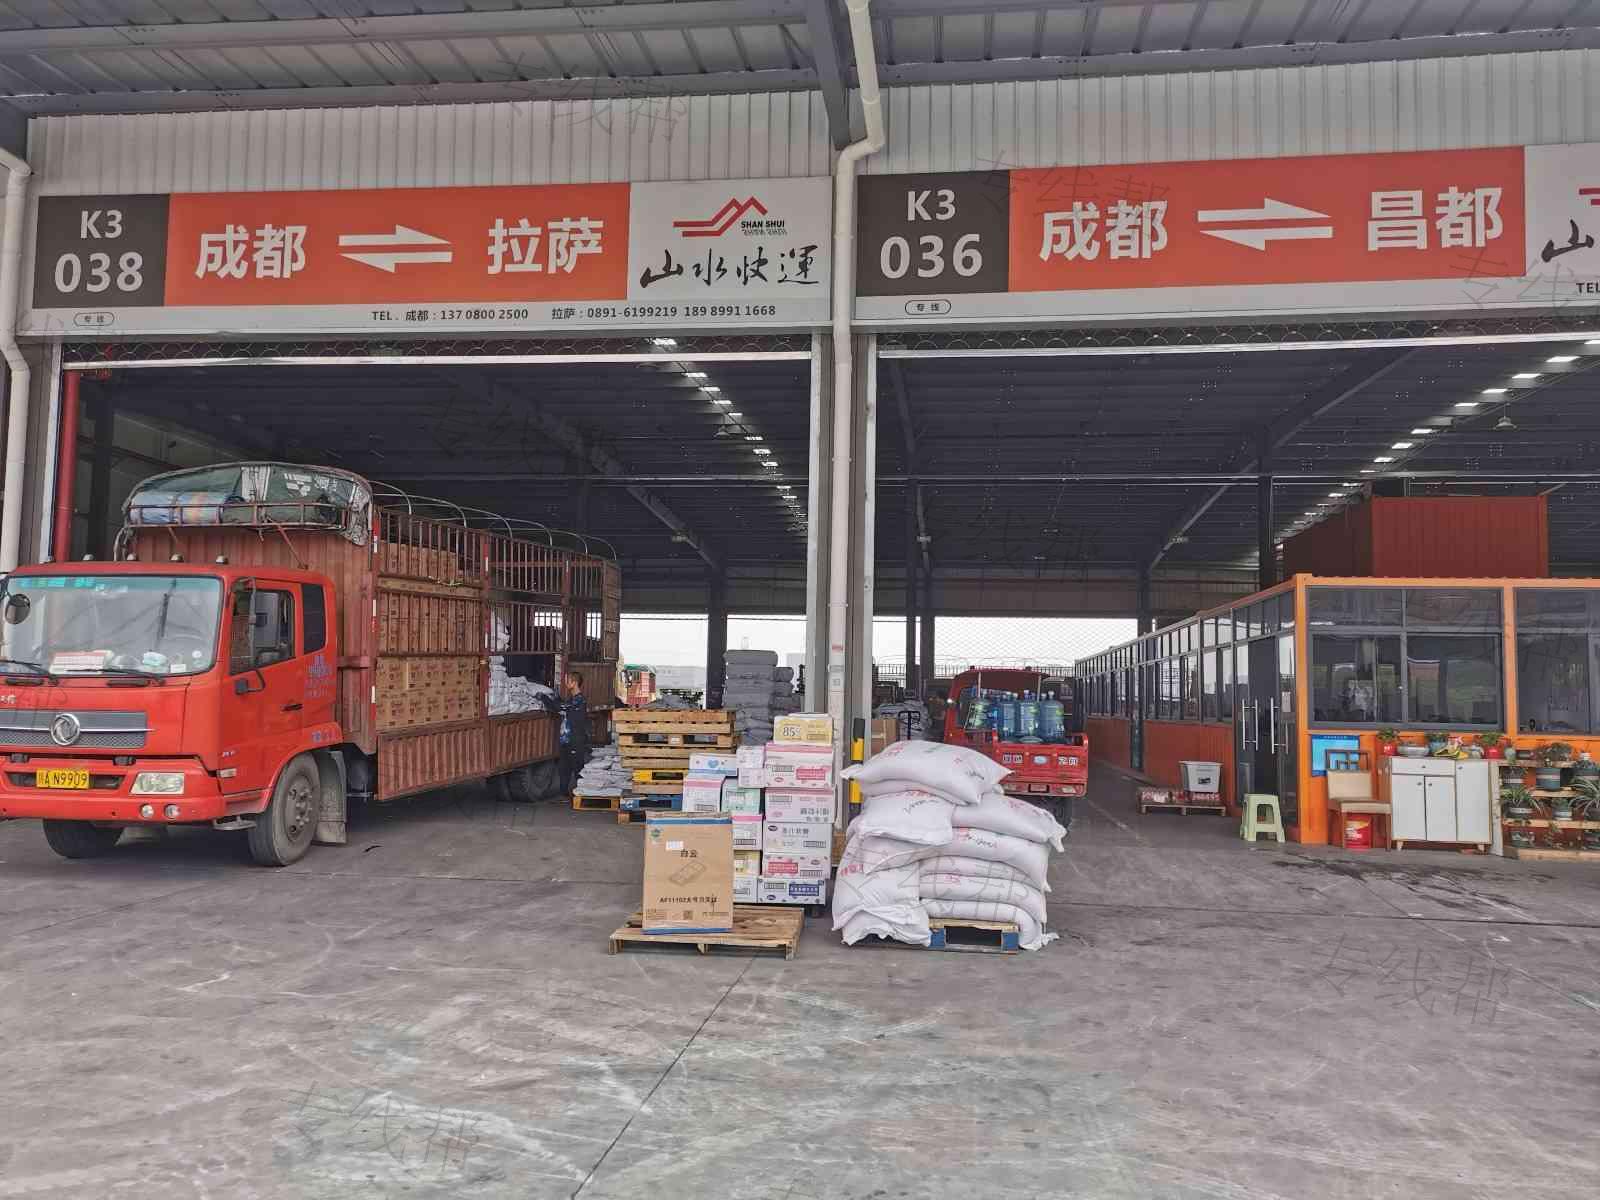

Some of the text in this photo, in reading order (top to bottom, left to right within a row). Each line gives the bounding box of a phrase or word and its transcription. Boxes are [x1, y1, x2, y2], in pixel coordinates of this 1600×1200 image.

[80, 210, 123, 239] K3
[741, 219, 785, 228] SHAN SHUI
[907, 189, 955, 221] K3
[1367, 186, 1503, 251] 昌都
[195, 223, 308, 279] 成都
[487, 217, 604, 276] 拉萨
[1039, 199, 1168, 261] 成都
[54, 251, 144, 293] 038
[880, 233, 983, 279] 036
[465, 308, 495, 320] 0800
[498, 308, 528, 320] 2500
[684, 305, 707, 317] 189
[710, 305, 740, 317] 8991
[744, 304, 776, 316] 1668
